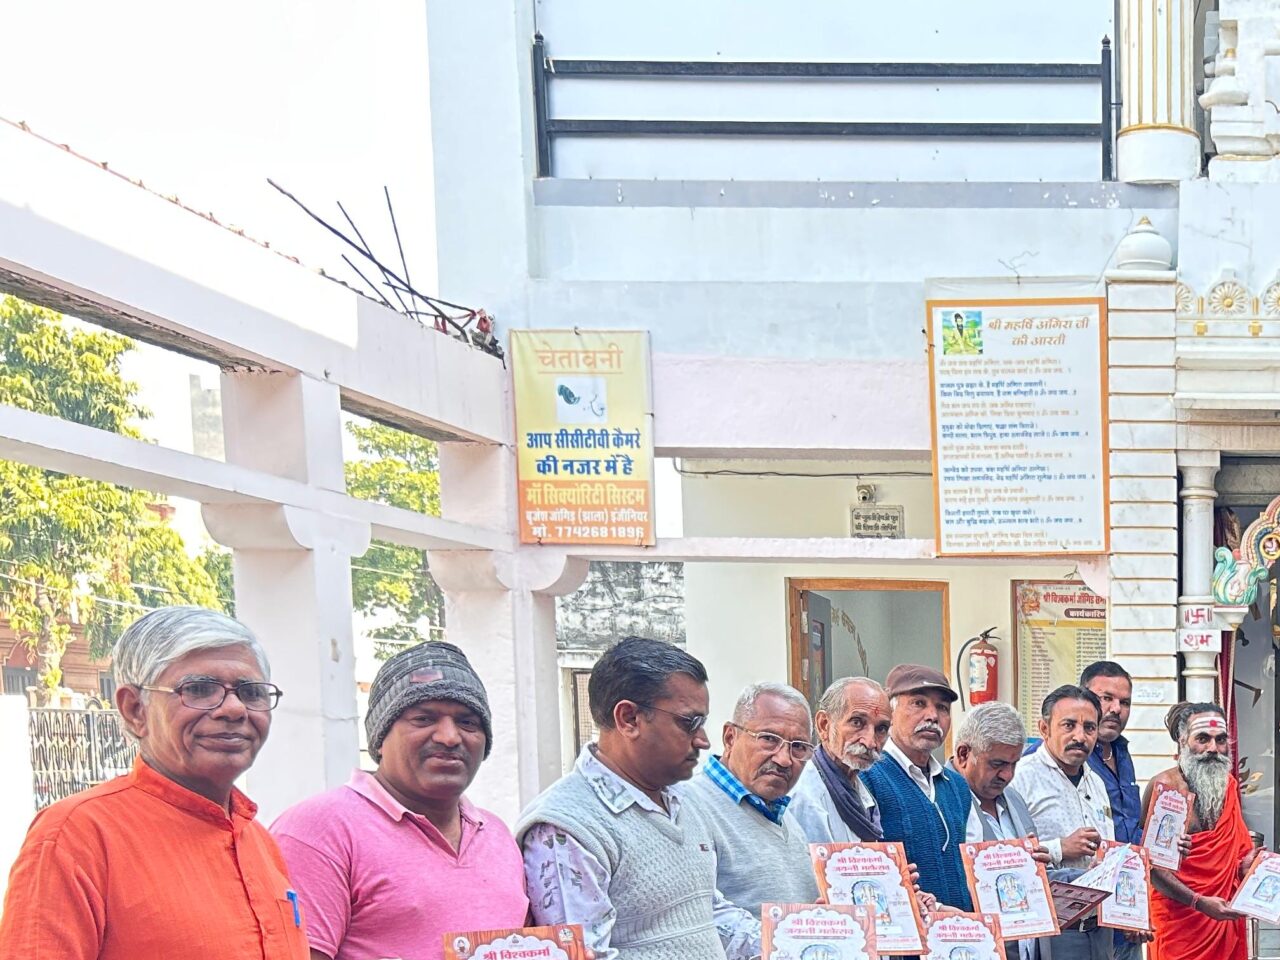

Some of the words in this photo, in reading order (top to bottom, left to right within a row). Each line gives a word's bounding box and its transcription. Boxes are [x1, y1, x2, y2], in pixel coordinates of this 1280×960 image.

[1030, 333, 1066, 346] आरती
[535, 341, 624, 368] चेतावनी
[526, 432, 552, 449] आप
[555, 428, 610, 449] सीसीटीवी
[612, 427, 641, 449] कैमरे
[535, 454, 559, 475] की
[562, 459, 601, 475] नजर
[604, 454, 620, 475] में
[621, 454, 634, 475] है
[543, 482, 605, 505] सिक्योरिटी
[606, 482, 646, 505] सिस्टम
[555, 526, 644, 538] 7742681896
[1184, 634, 1213, 650] शुभ
[500, 947, 551, 960] विश्वकर्मा
